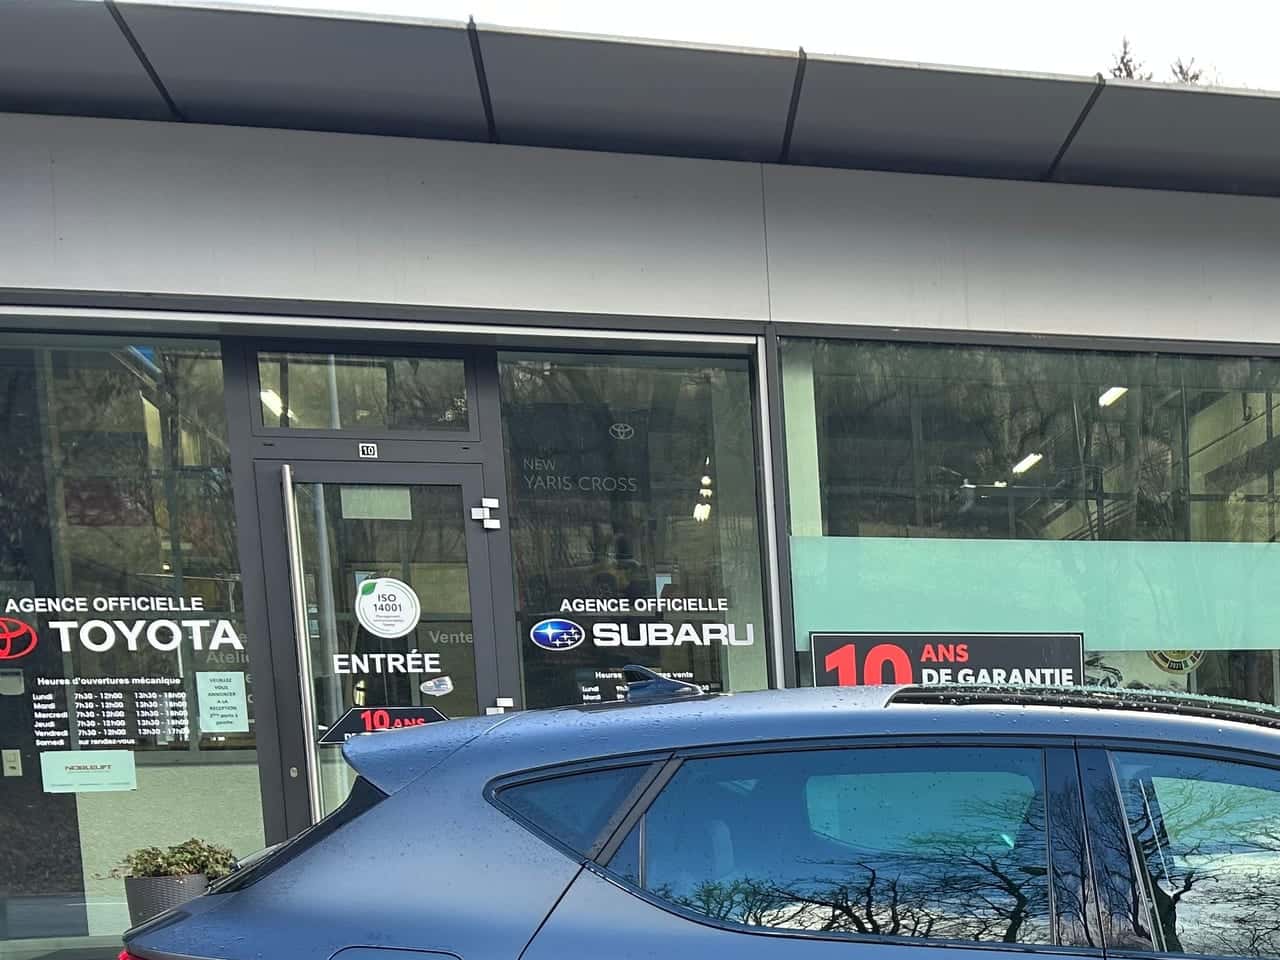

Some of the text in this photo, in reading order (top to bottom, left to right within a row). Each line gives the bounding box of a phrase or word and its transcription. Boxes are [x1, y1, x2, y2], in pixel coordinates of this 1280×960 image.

[362, 446, 374, 455] 10
[523, 456, 555, 470] NEW
[523, 475, 638, 492] YARIS CROSS
[5, 597, 204, 613] AGENCE OFFICIELLE
[377, 593, 397, 602] ISO
[373, 603, 402, 612] 14001
[560, 598, 728, 613] AGENCE OFFICIELLE
[49, 619, 245, 652] TOYOTA
[429, 630, 473, 644] Vente
[592, 623, 755, 647] SUBARU
[333, 649, 441, 674] ENTRÉE
[825, 643, 969, 687] 10 ANS
[37, 677, 70, 685] Heures
[922, 668, 1073, 686] DE GARANTIE
[74, 692, 93, 700] 7h30
[361, 710, 390, 731] 10
